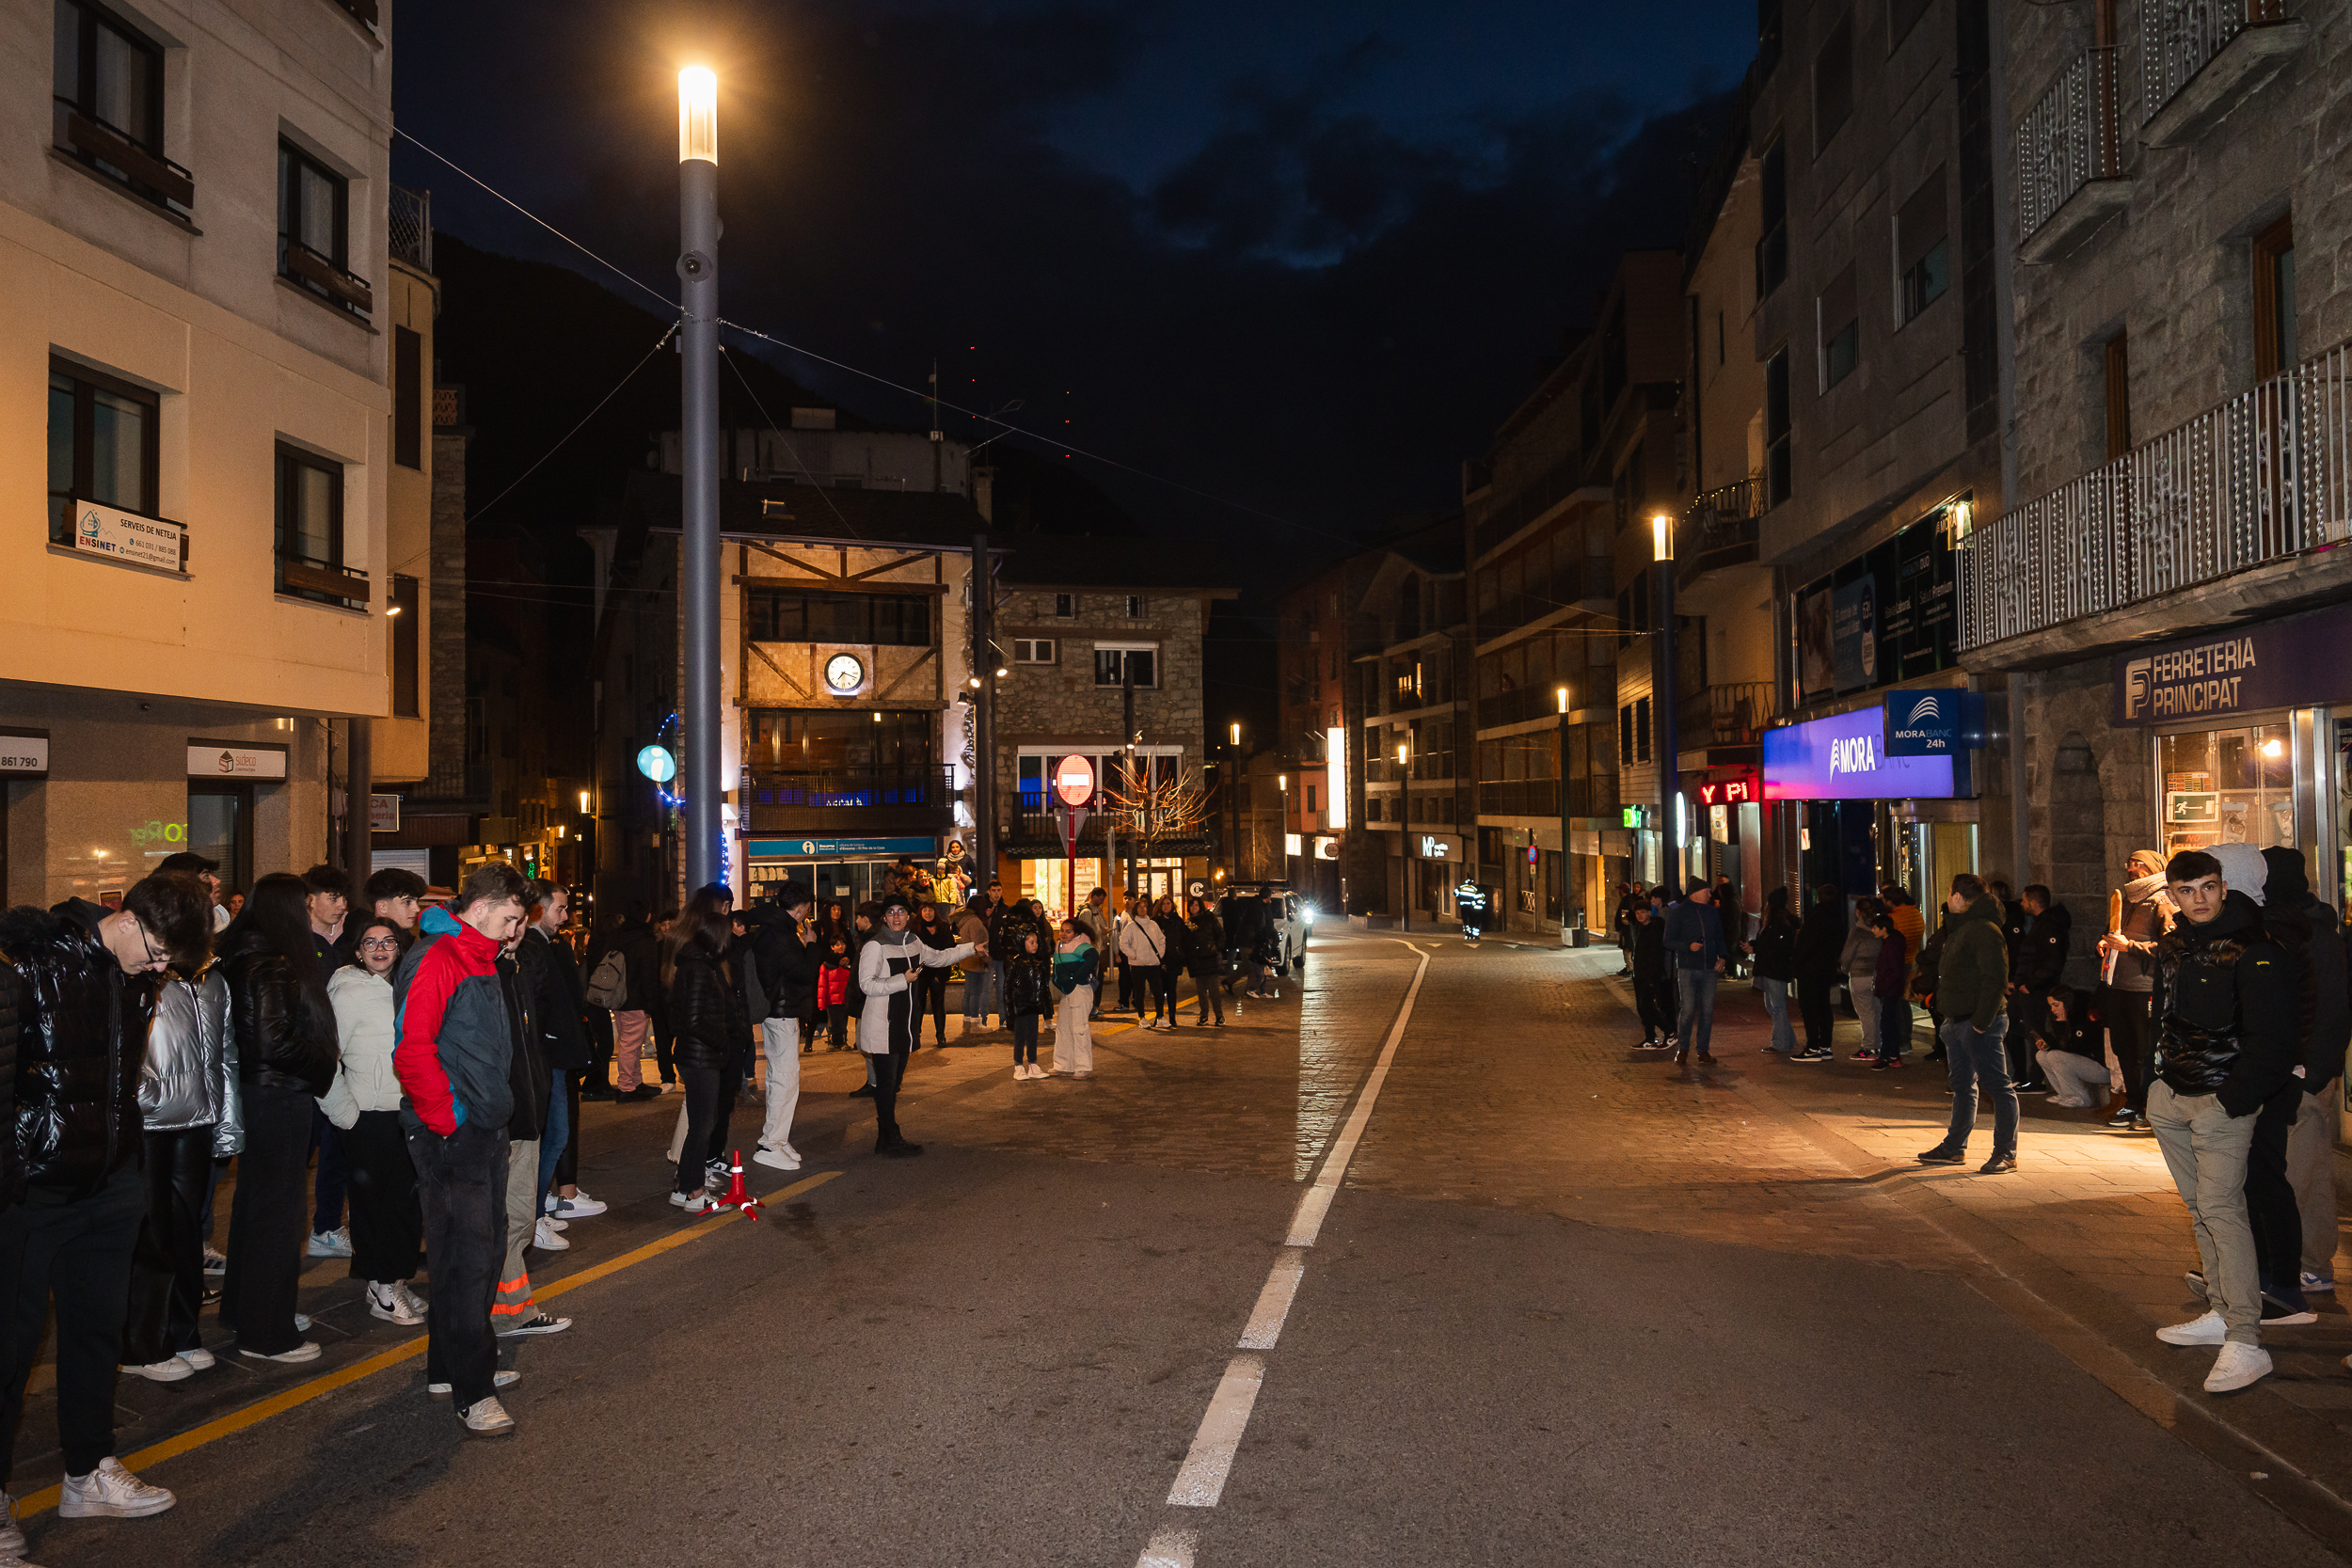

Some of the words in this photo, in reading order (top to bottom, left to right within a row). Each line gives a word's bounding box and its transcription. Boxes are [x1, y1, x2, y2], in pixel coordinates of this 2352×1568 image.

[120, 518, 145, 532] SERVEIS
[146, 525, 154, 534] DE
[155, 528, 177, 540] NETEJA
[79, 535, 117, 552] ENSINET
[135, 539, 145, 548] 661
[145, 542, 154, 551] 031
[158, 545, 167, 554] 885
[167, 546, 177, 556] 088
[125, 548, 176, 565] ensinet21@gmail.com
[1932, 580, 1953, 599] Premium
[2153, 636, 2257, 683] FERRETERIA
[2153, 675, 2242, 716] PRINCIPAT
[1895, 728, 1952, 738] MORABANC
[1926, 738, 1946, 749] 24h
[1, 756, 17, 767] 861
[20, 756, 38, 768] 790
[1702, 784, 1716, 803] Y
[2185, 834, 2201, 843] NO
